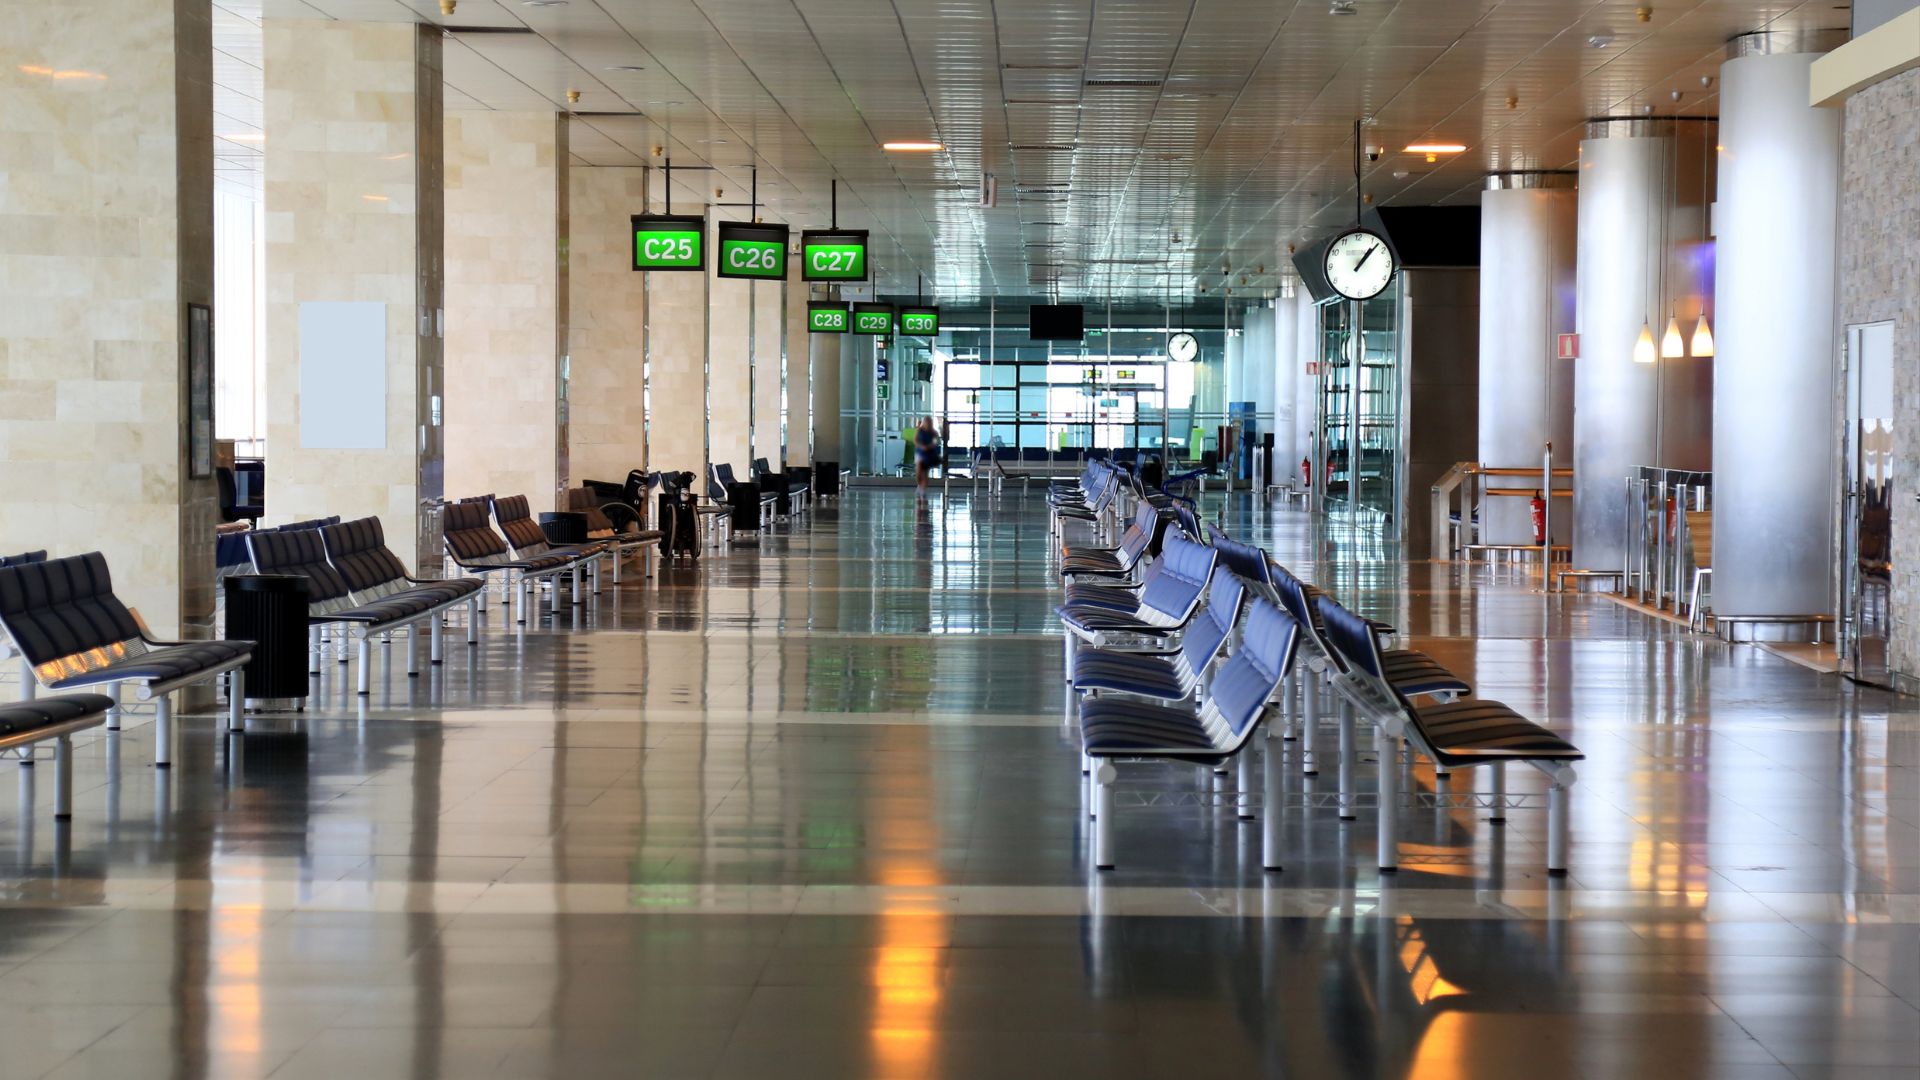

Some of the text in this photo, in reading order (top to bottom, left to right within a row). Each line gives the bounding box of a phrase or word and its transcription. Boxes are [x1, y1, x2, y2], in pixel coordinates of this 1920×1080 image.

[644, 238, 693, 260] C25
[729, 247, 776, 269] C26
[812, 251, 856, 272] C27
[814, 314, 842, 327] C28
[859, 316, 887, 329] C29
[905, 318, 933, 331] C30
